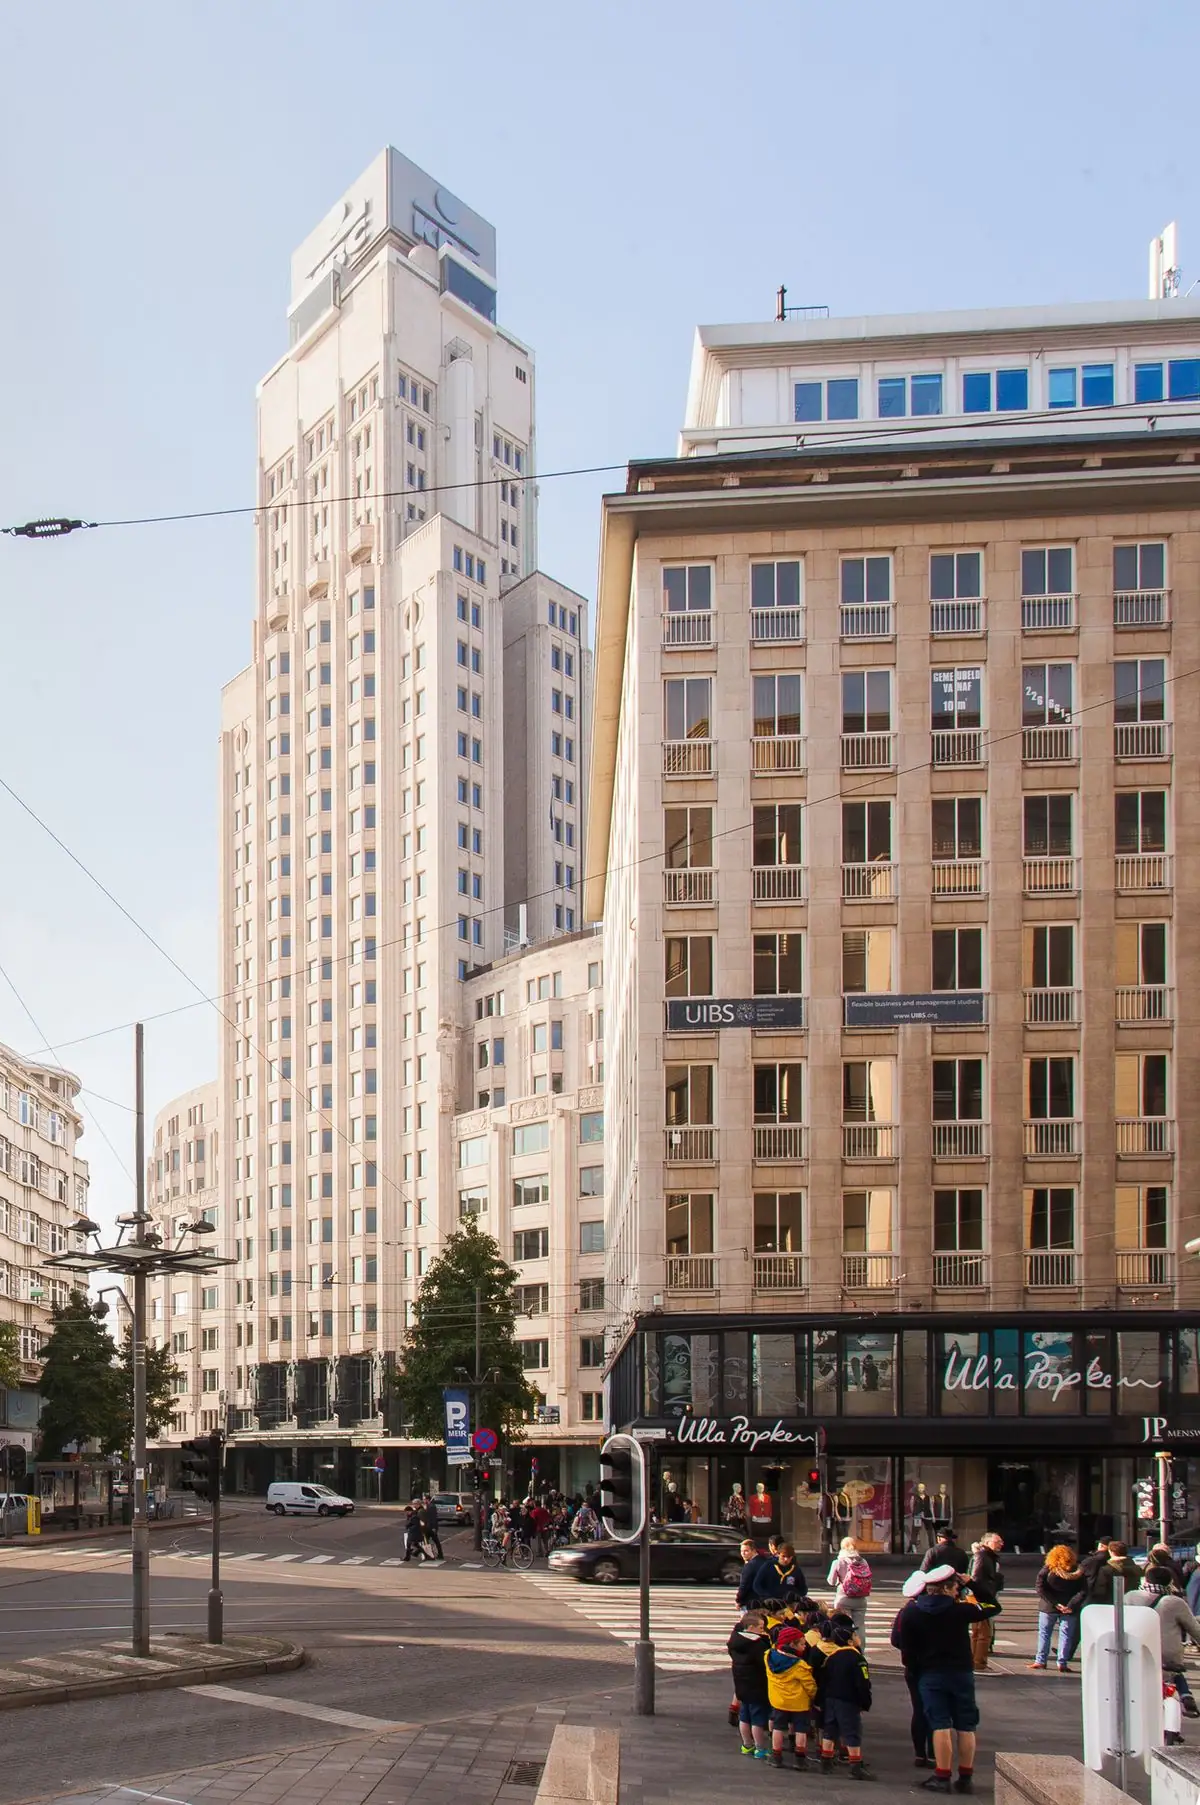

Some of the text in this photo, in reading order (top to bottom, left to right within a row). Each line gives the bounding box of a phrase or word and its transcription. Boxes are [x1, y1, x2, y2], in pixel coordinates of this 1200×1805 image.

[685, 1004, 735, 1023] UIBS
[1024, 1351, 1162, 1402] Popken
[446, 1401, 467, 1429] P
[677, 1415, 815, 1451] Ulla Popken
[1141, 1417, 1167, 1443] JP
